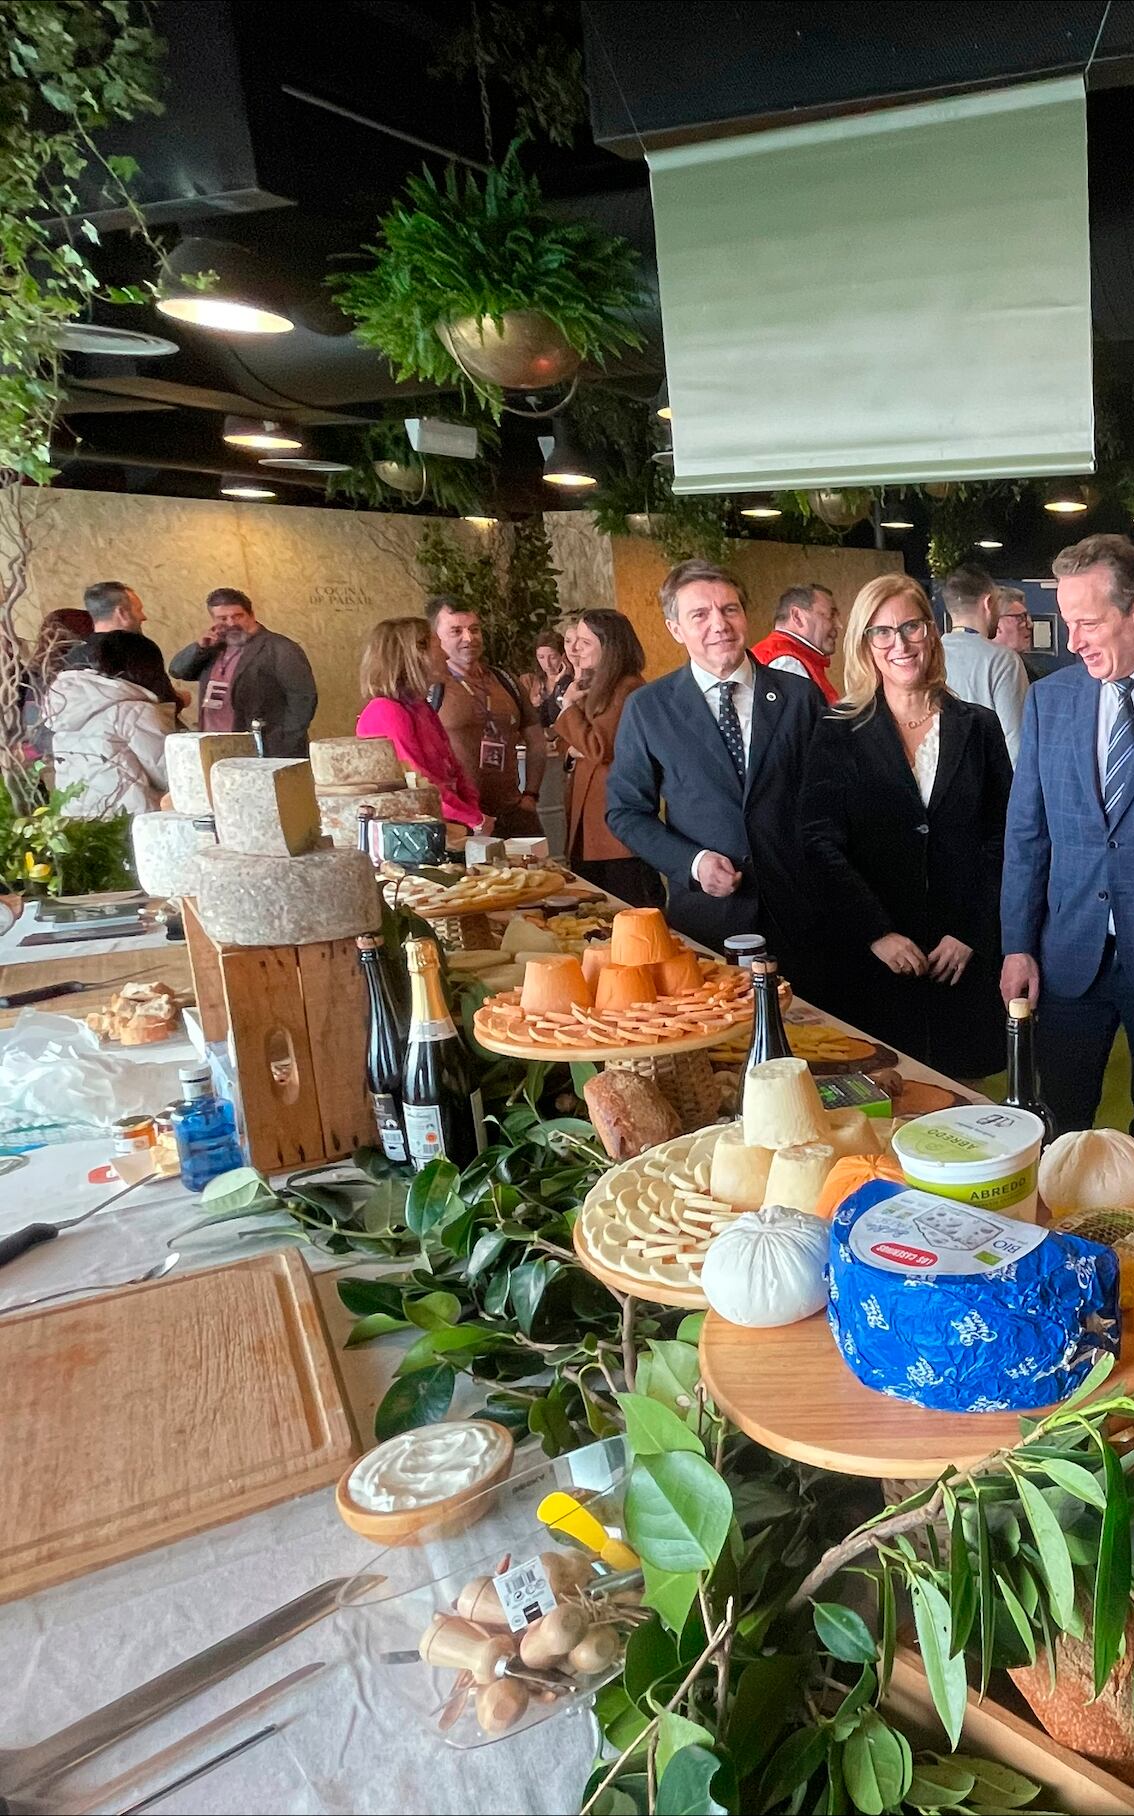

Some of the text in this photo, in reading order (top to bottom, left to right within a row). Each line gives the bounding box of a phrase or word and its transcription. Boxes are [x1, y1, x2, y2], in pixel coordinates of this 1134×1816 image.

[927, 1127, 978, 1151] ABREDO
[970, 1176, 1026, 1202] ABREDO
[993, 1239, 1022, 1255] BIO
